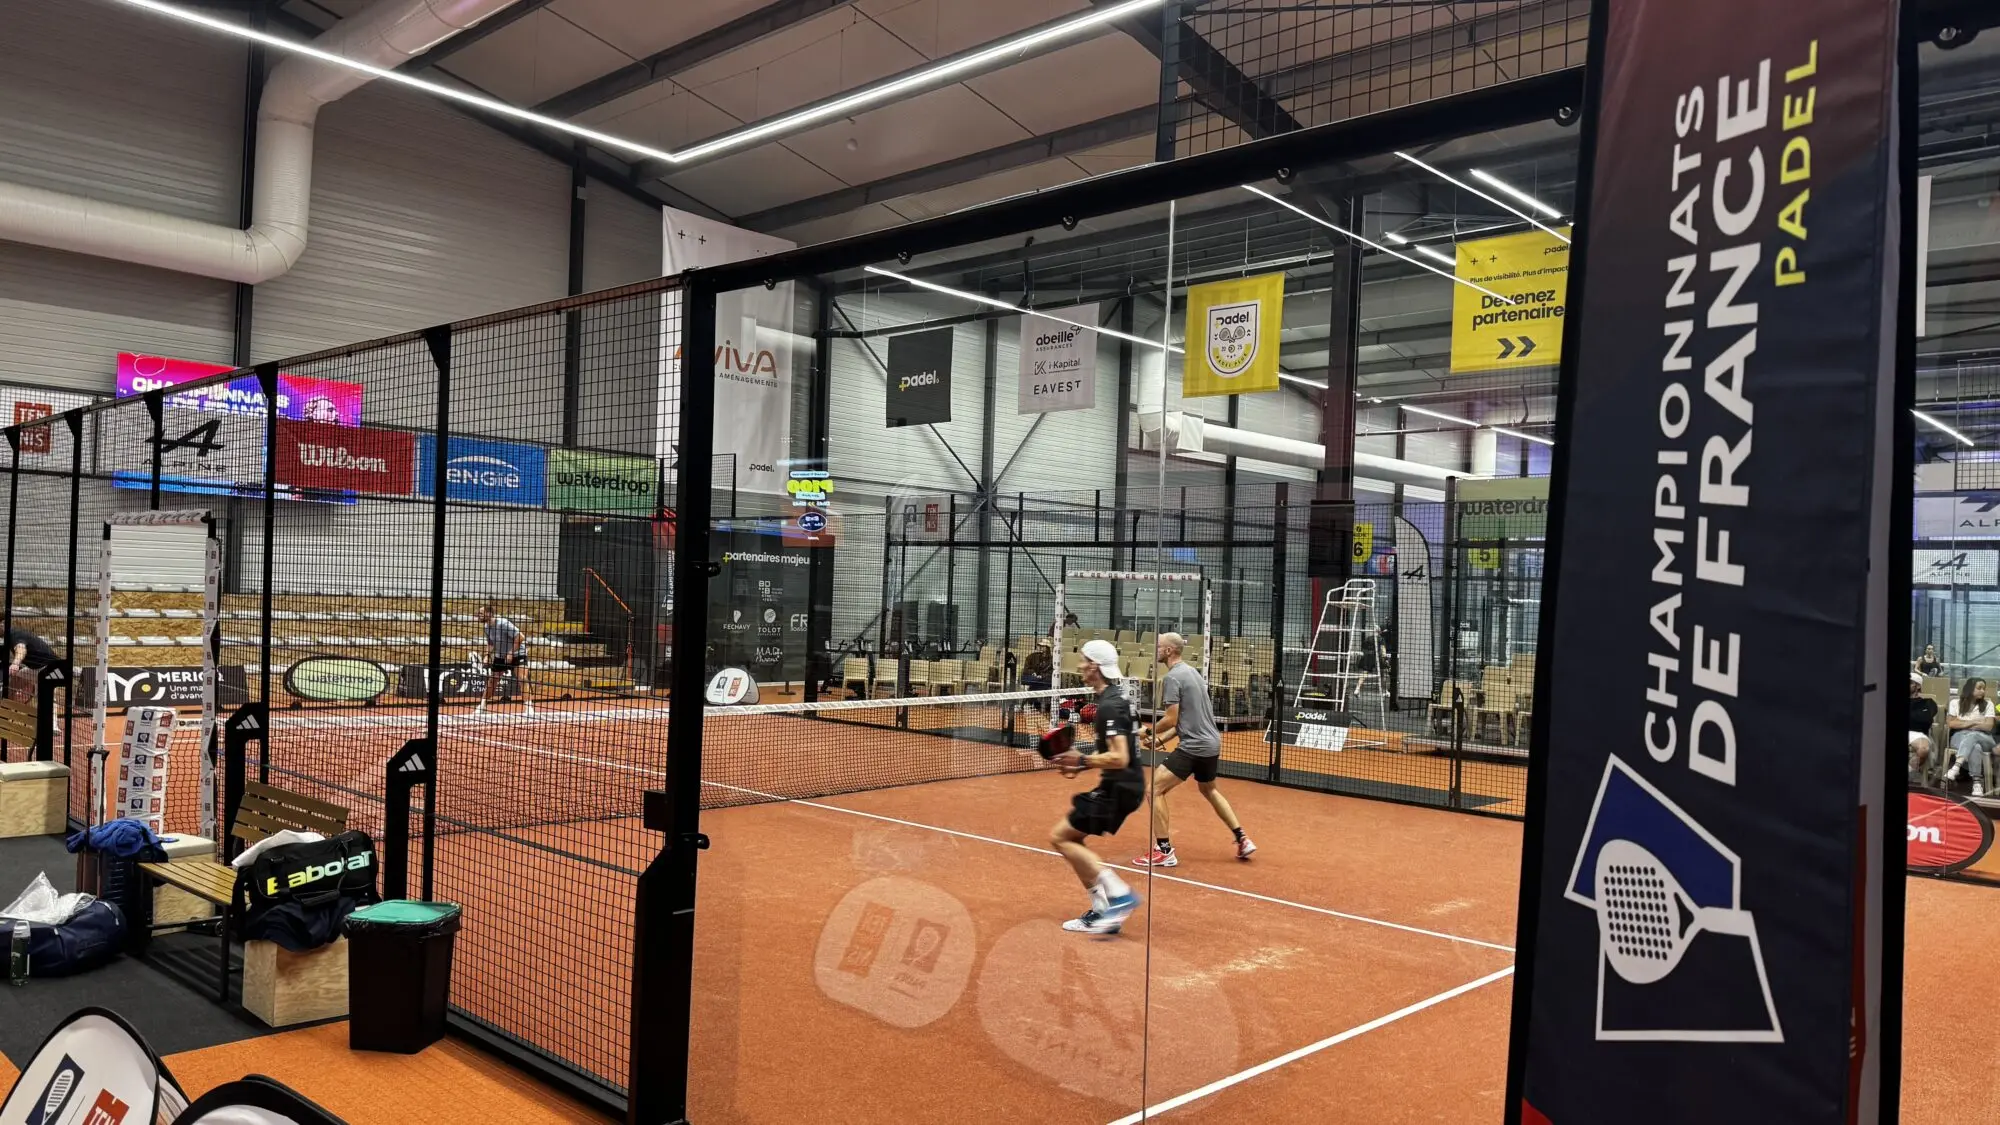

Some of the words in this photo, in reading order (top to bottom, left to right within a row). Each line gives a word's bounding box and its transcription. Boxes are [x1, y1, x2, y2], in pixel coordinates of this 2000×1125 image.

[1774, 39, 1818, 287] PADEL
[1522, 269, 1537, 277] Plus
[1481, 289, 1556, 309] Devenez
[1472, 303, 1564, 331] partenaire
[1696, 58, 1771, 587] FRANCE
[1035, 330, 1074, 346] abeille
[1033, 380, 1081, 395] EAVEST
[1644, 86, 1705, 763] CHAMPIONNATS
[297, 442, 391, 473] Wilson
[557, 470, 650, 495] waterdrop
[1465, 496, 1546, 515] waterdr
[1354, 542, 1364, 556] 6
[781, 554, 810, 567] majeu
[1688, 624, 1741, 787] DE
